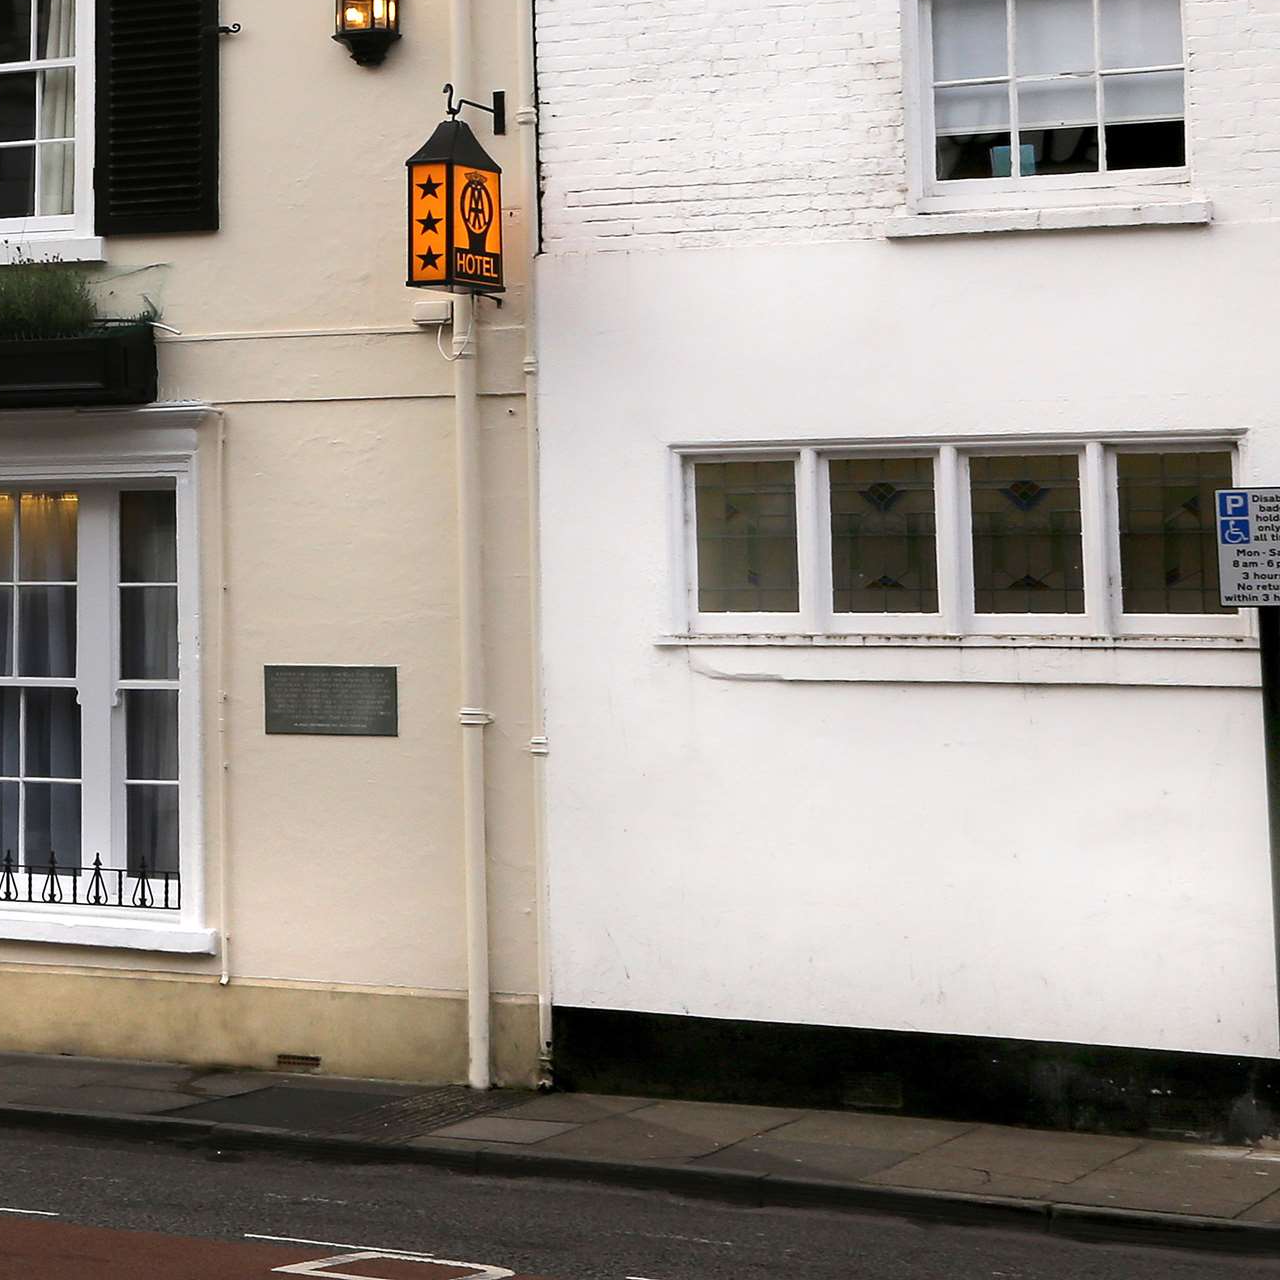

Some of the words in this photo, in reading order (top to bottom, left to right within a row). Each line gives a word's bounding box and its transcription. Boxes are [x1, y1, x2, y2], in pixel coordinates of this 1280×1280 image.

[456, 251, 499, 278] HOTEL
[1226, 495, 1244, 515] P
[1255, 514, 1280, 522] hold
[1236, 549, 1260, 557] Mon
[1232, 560, 1240, 568] 8
[1267, 560, 1274, 568] 6
[1242, 572, 1249, 580] 3
[1253, 572, 1280, 580] hour
[1237, 582, 1253, 591] No
[1224, 594, 1259, 602] within
[1262, 594, 1270, 602] 3
